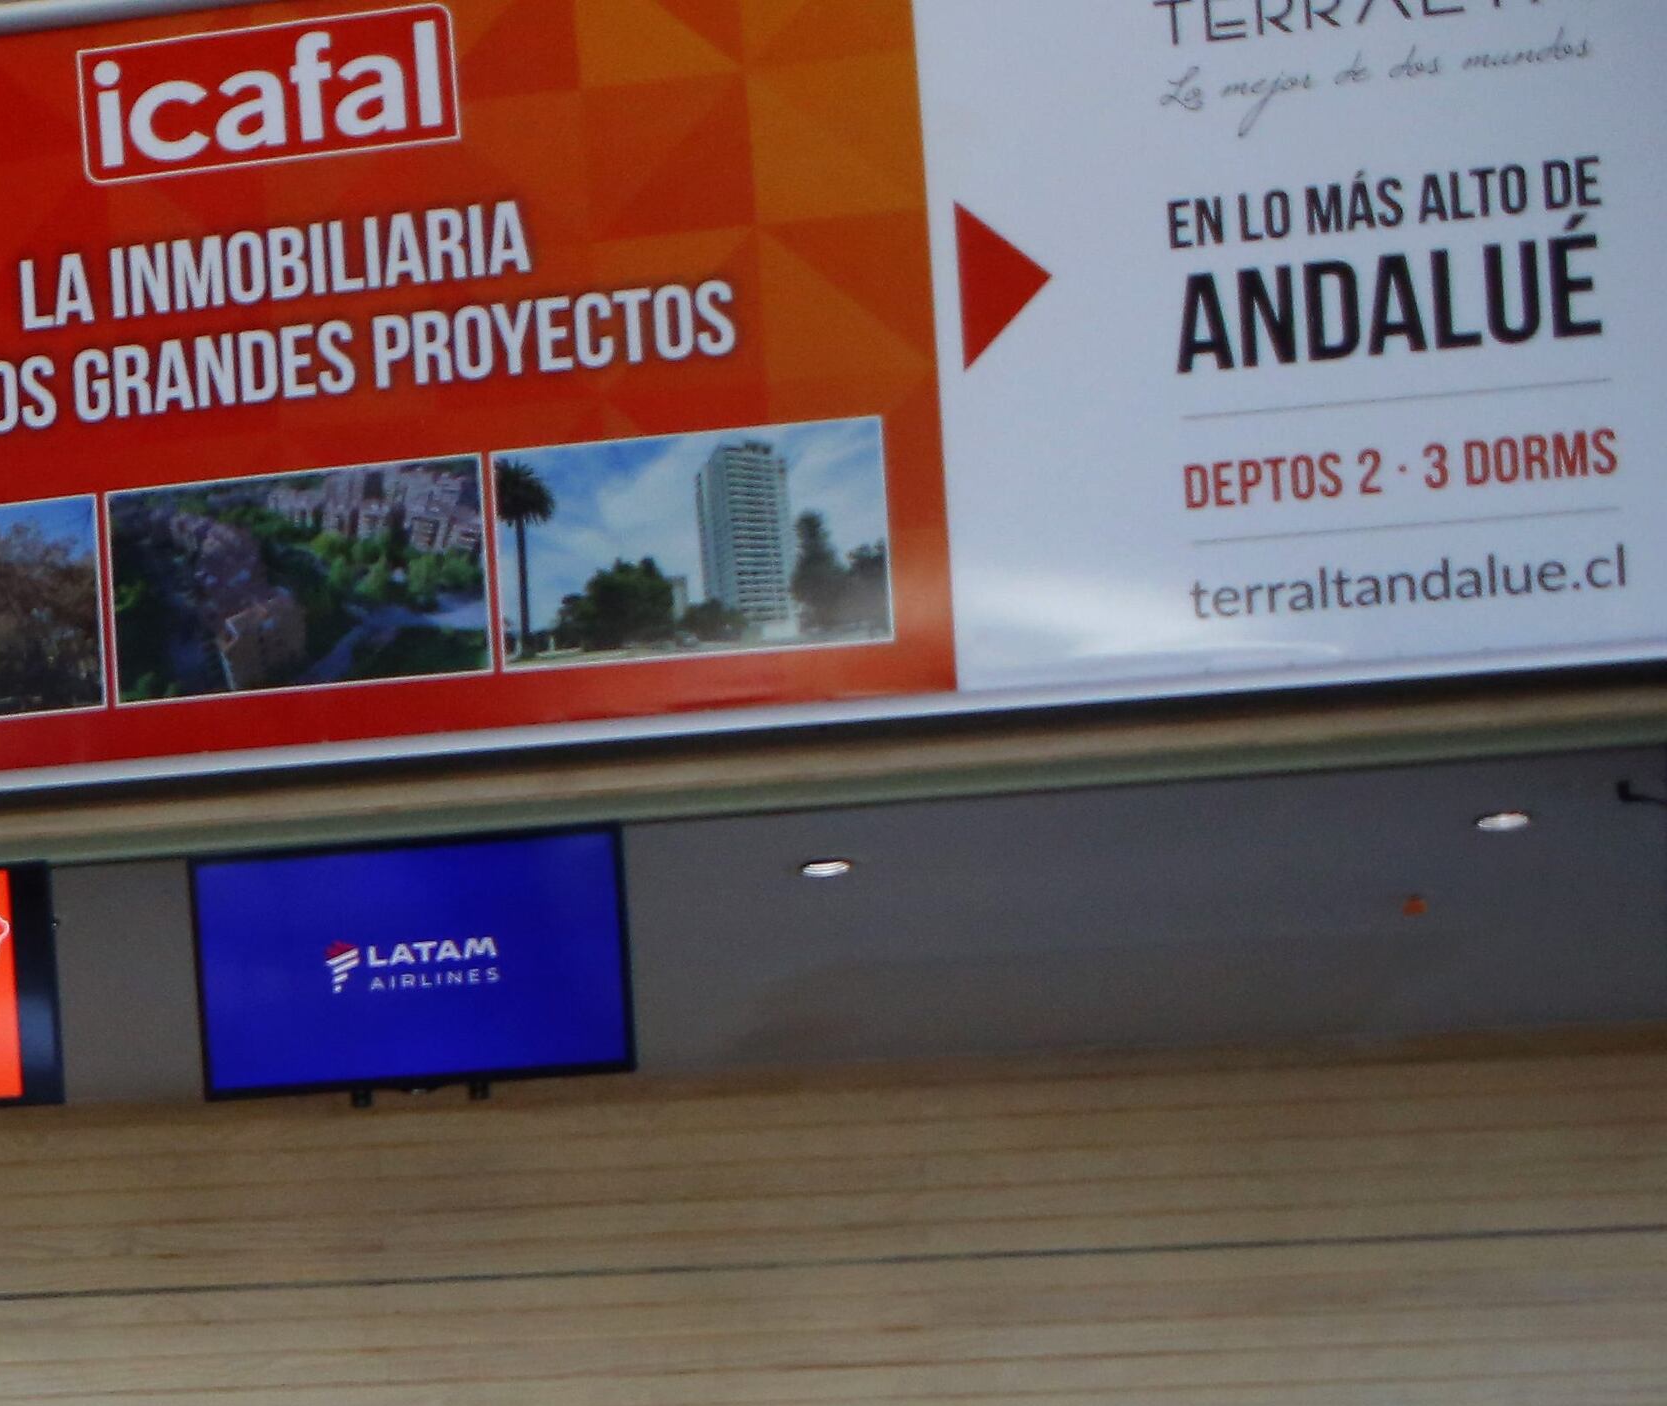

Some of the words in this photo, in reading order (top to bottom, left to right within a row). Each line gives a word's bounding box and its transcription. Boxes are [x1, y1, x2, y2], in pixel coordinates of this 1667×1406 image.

[94, 18, 448, 171] icafal
[1220, 71, 1313, 138] mejor
[1334, 51, 1369, 85] de
[1388, 44, 1440, 79] dos
[1463, 26, 1590, 71] mundos
[1168, 199, 1224, 249] EN
[1240, 191, 1291, 241] LO
[1306, 172, 1404, 231] MÁS
[1419, 164, 1527, 223] ALTO
[1545, 156, 1601, 209] DE
[18, 252, 93, 330] LA
[112, 200, 531, 319] INMOBILIARIA
[1176, 214, 1603, 375] ANDALUÉ
[74, 319, 354, 424] GRANDES
[374, 280, 736, 393] PROYECTOS
[1184, 452, 1343, 510] DEPTOS
[1359, 450, 1382, 494] 2
[1424, 444, 1449, 489] 3
[1465, 428, 1618, 487] DORMS
[1189, 544, 1628, 619] terraltandalue.cl
[368, 936, 498, 967] LATAM
[370, 967, 501, 991] AIRLINES
